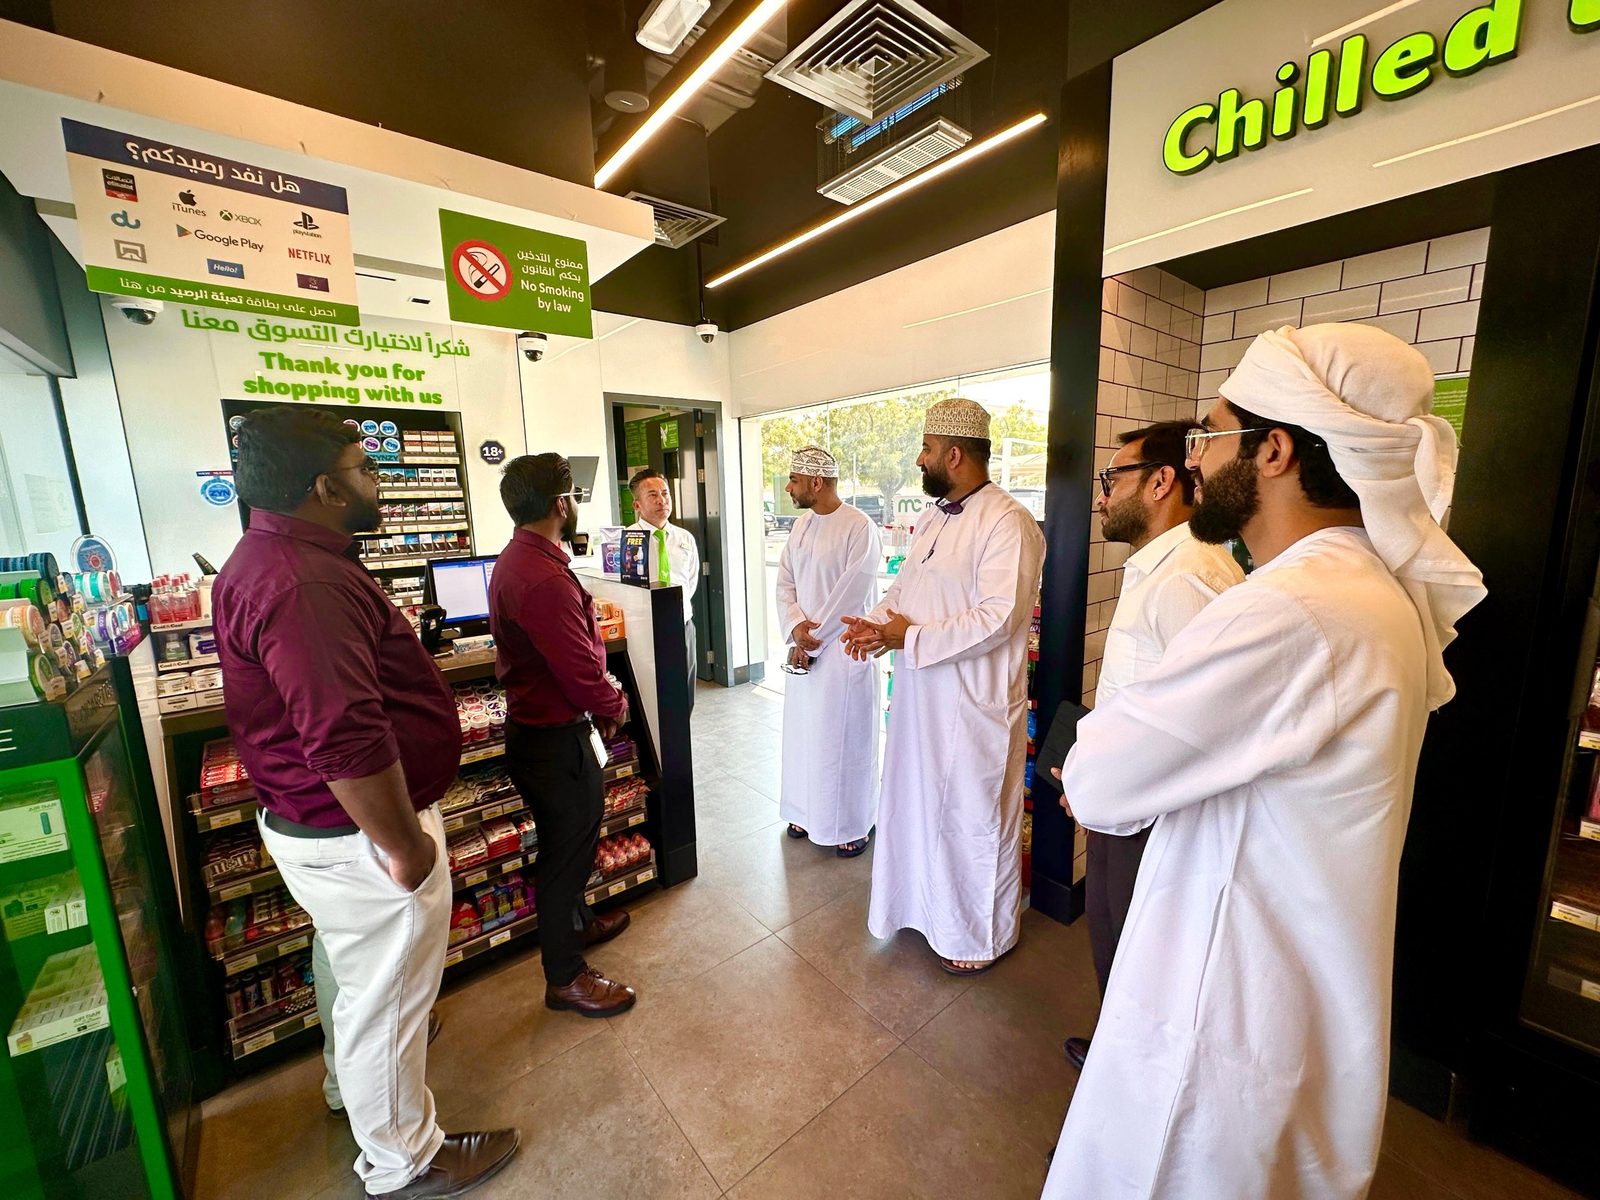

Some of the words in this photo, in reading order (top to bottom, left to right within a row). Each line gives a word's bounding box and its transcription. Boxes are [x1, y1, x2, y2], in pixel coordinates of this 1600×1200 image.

[1163, 0, 1523, 175] Chilled
[126, 142, 224, 180] رصيدكم؟
[231, 168, 264, 185] نفد
[270, 175, 301, 194] هل
[172, 202, 206, 216] iTunes
[234, 214, 262, 226] XBOX
[194, 230, 239, 246] Google
[241, 238, 264, 252] Play
[288, 248, 332, 265] NETFLIX
[517, 250, 551, 263] التدخين
[213, 264, 238, 274] Hello!
[522, 264, 555, 277] القانون
[554, 258, 583, 270] ممنوع
[559, 271, 581, 282] بحكم
[120, 278, 142, 290] هنا
[146, 283, 165, 294] من
[521, 280, 537, 291] No
[539, 283, 584, 302] Smoking
[170, 287, 207, 301] الرصيد
[210, 292, 243, 306] تعبئة
[246, 296, 280, 312] بطاقة
[282, 303, 306, 313] على
[538, 298, 551, 311] by
[554, 299, 571, 312] law
[309, 308, 336, 317] احصل
[182, 309, 240, 332] معنا
[248, 318, 338, 342] التسوق
[344, 329, 422, 352] لاختيارك
[258, 352, 341, 375] Thank
[345, 364, 387, 381] you
[392, 363, 425, 381] for
[243, 376, 360, 404] shopping
[364, 385, 414, 402] with
[419, 392, 442, 404] us
[483, 446, 503, 456] 18+
